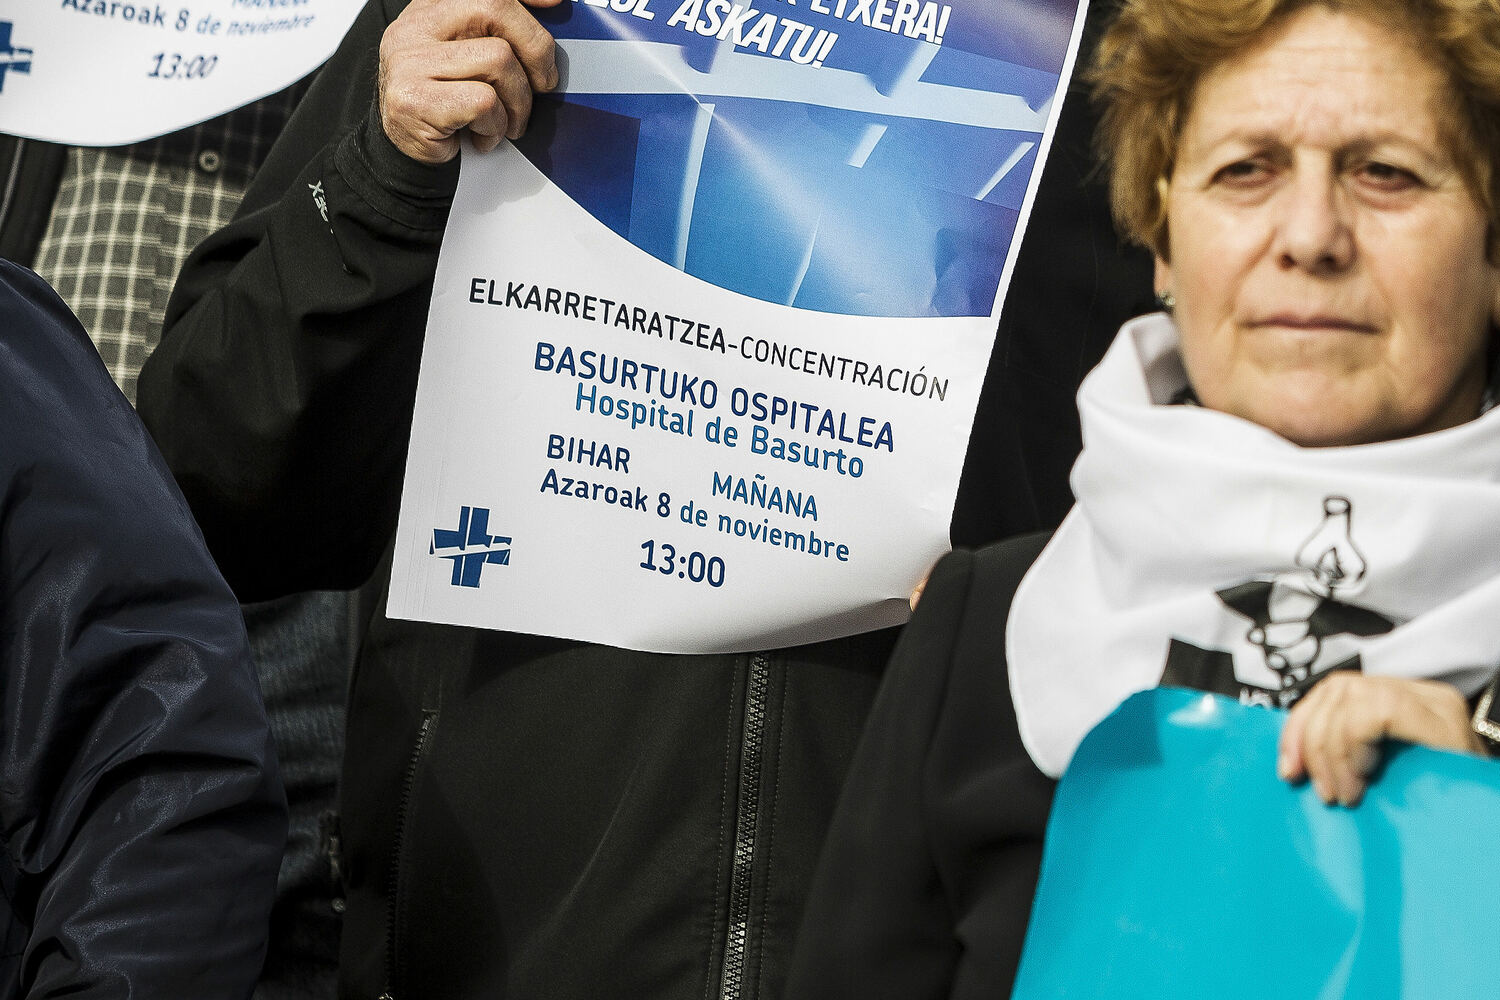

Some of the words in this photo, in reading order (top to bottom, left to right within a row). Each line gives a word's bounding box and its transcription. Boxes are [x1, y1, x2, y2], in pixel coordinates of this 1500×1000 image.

[175, 9, 190, 31] 8
[196, 15, 221, 36] de
[227, 12, 316, 36] noviembre
[147, 51, 218, 81] 13:00
[469, 277, 949, 402] ELKARRETARATZEA-CONCENTRACIÓN
[534, 341, 718, 410] BASURTUKO
[731, 386, 895, 453] OSPITALEA
[546, 433, 631, 474] BIHAR
[575, 381, 693, 438] Hospital
[705, 414, 738, 448] de
[751, 424, 864, 479] Basurto
[540, 468, 648, 513] Azaroak
[656, 492, 671, 517] 8
[680, 501, 708, 528] de
[718, 512, 850, 563] noviembre
[712, 470, 818, 522] MAÑANA
[640, 539, 726, 589] 13:00
